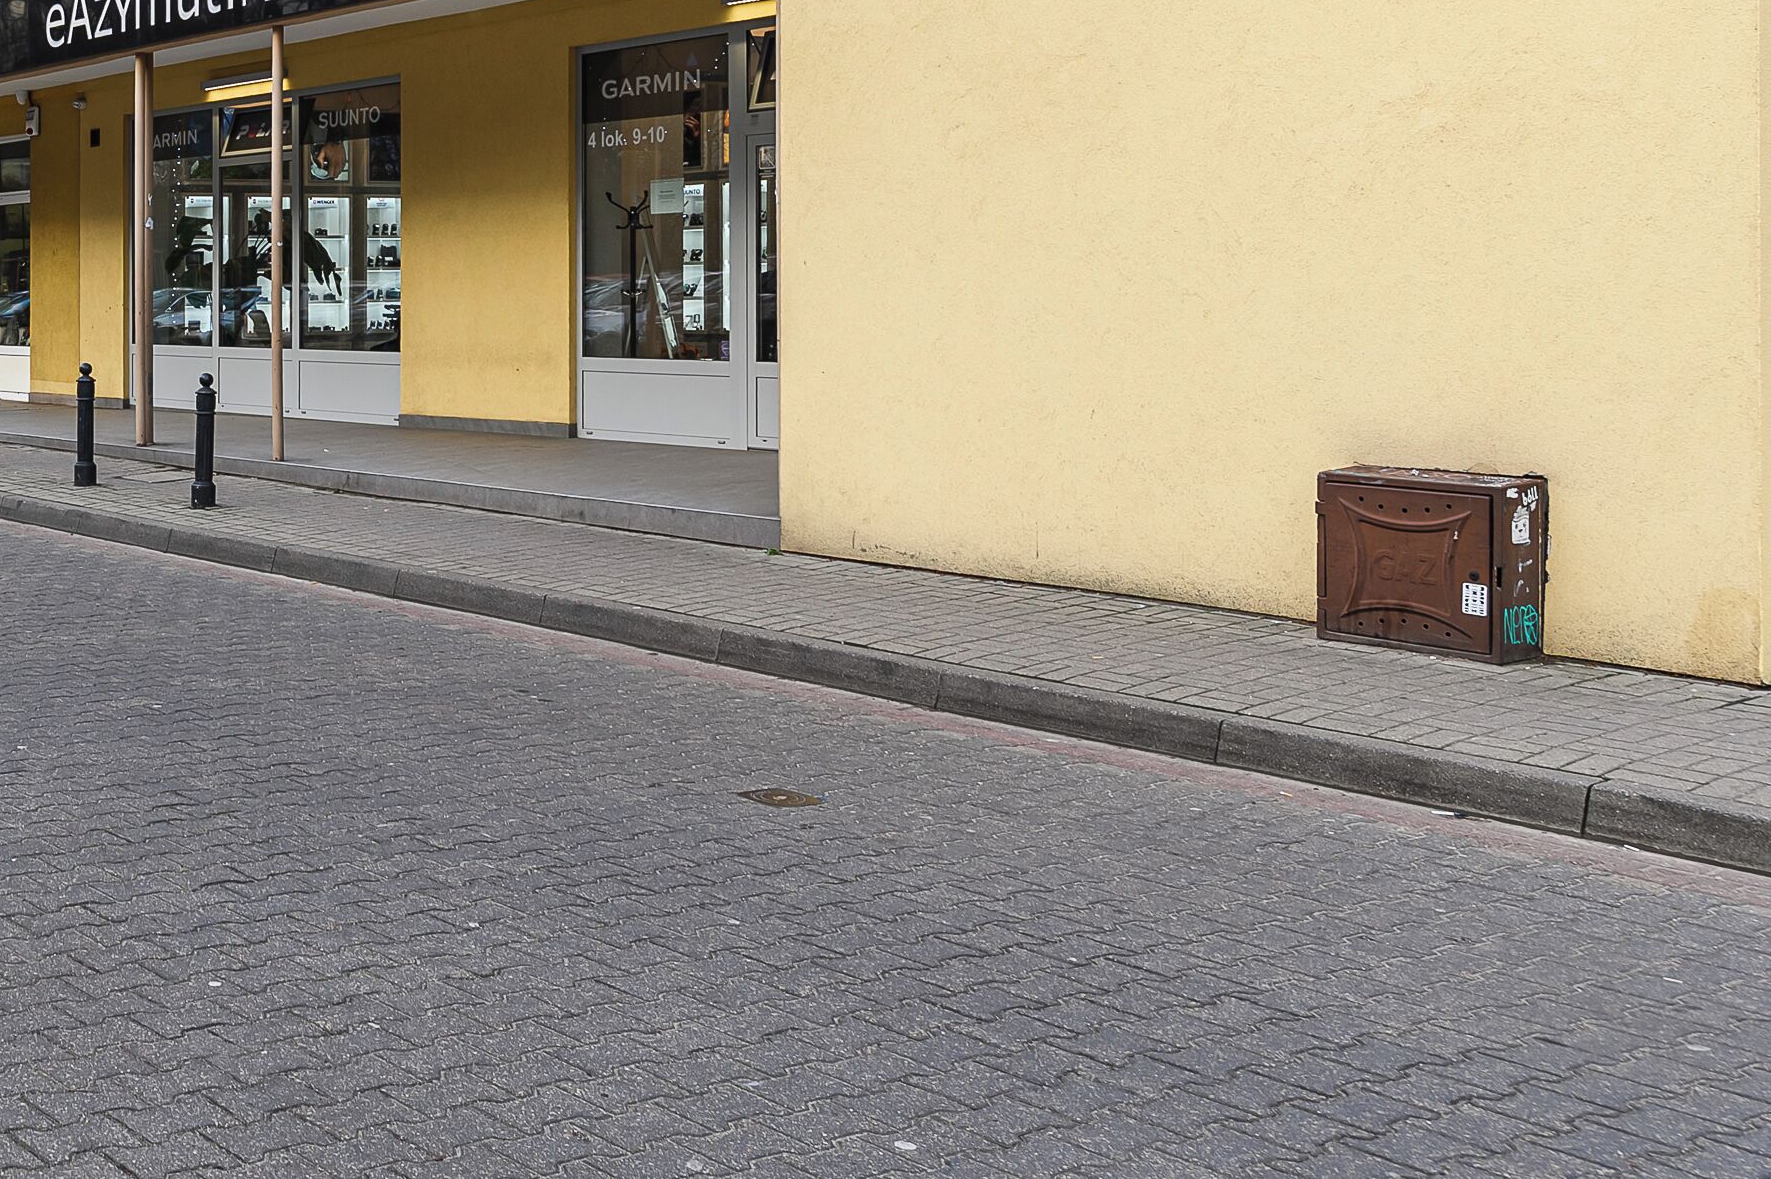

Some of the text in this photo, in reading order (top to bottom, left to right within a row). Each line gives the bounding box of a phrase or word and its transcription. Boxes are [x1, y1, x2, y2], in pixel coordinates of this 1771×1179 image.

[601, 69, 700, 99] GARMIN
[318, 106, 381, 129] SUUNTO
[153, 129, 198, 149] ARMIN
[588, 126, 665, 148] 4 lok. 9-10
[1371, 549, 1437, 586] GAZ
